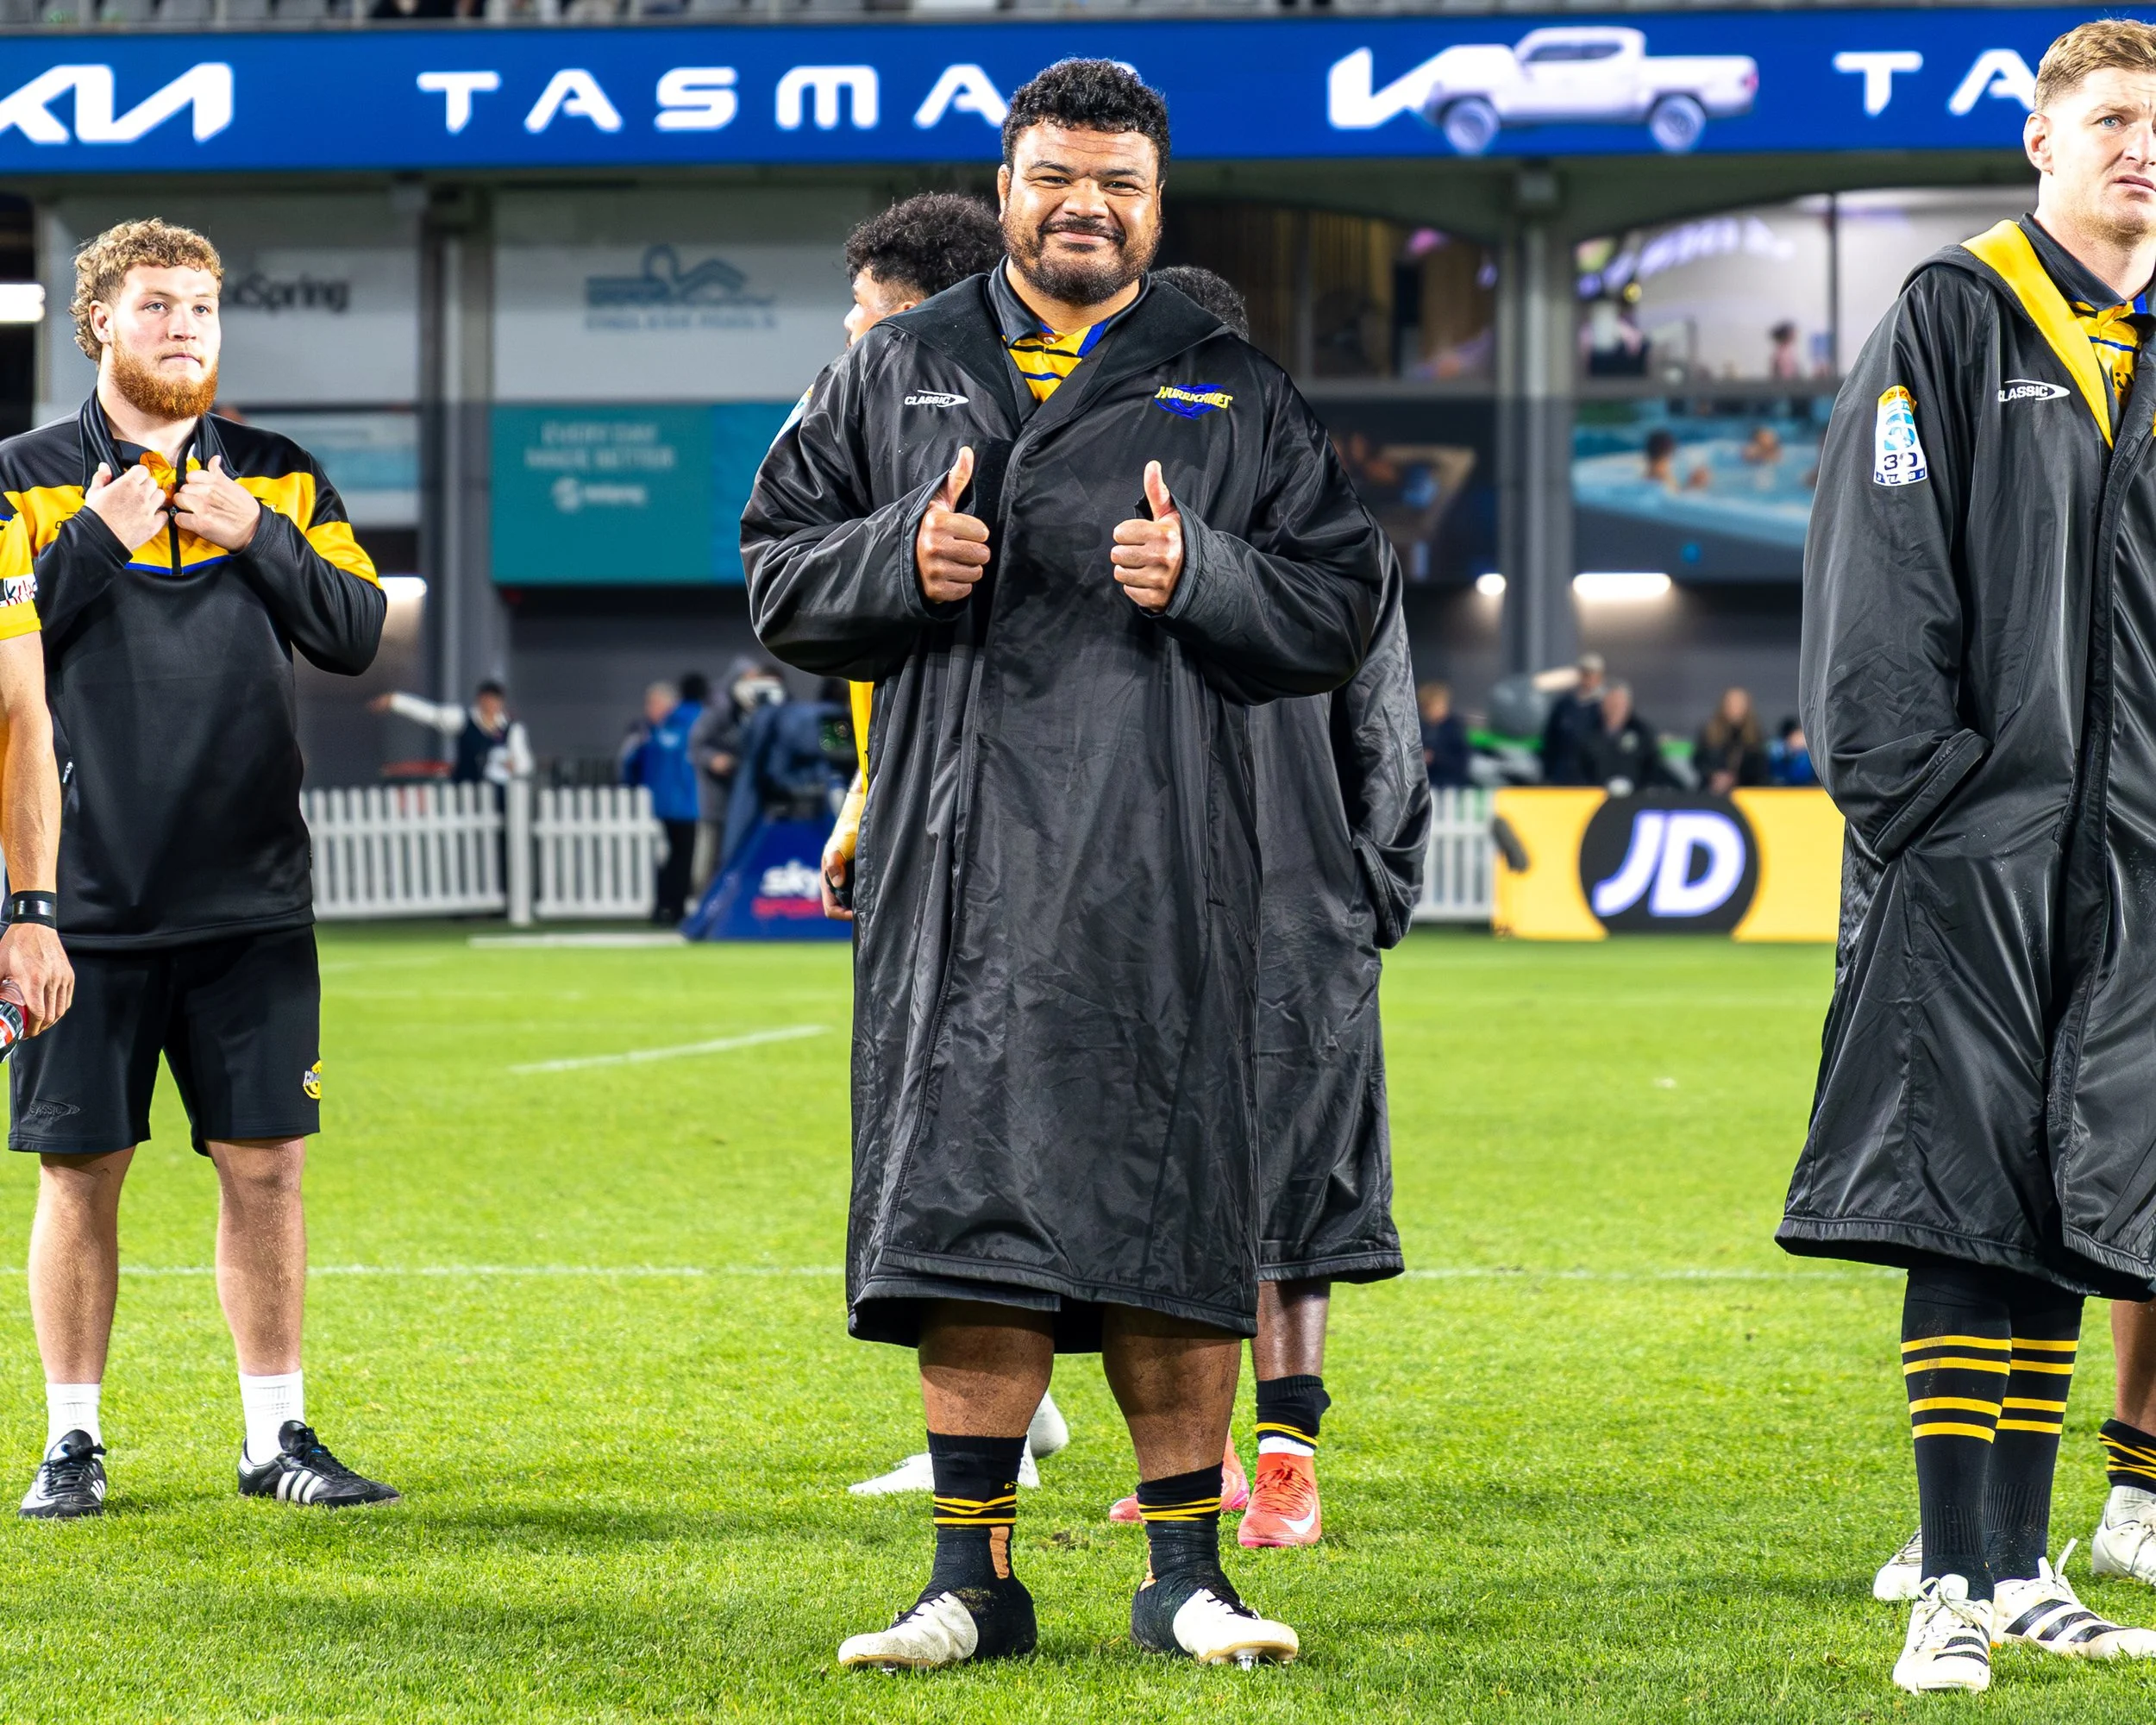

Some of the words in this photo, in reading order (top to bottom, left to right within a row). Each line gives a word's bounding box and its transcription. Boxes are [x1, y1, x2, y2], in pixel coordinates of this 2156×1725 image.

[417, 62, 1137, 135] TASMA
[904, 395, 951, 405] CLASSIC
[1154, 386, 1233, 409] HURRICANES
[1592, 809, 1747, 917] JD
